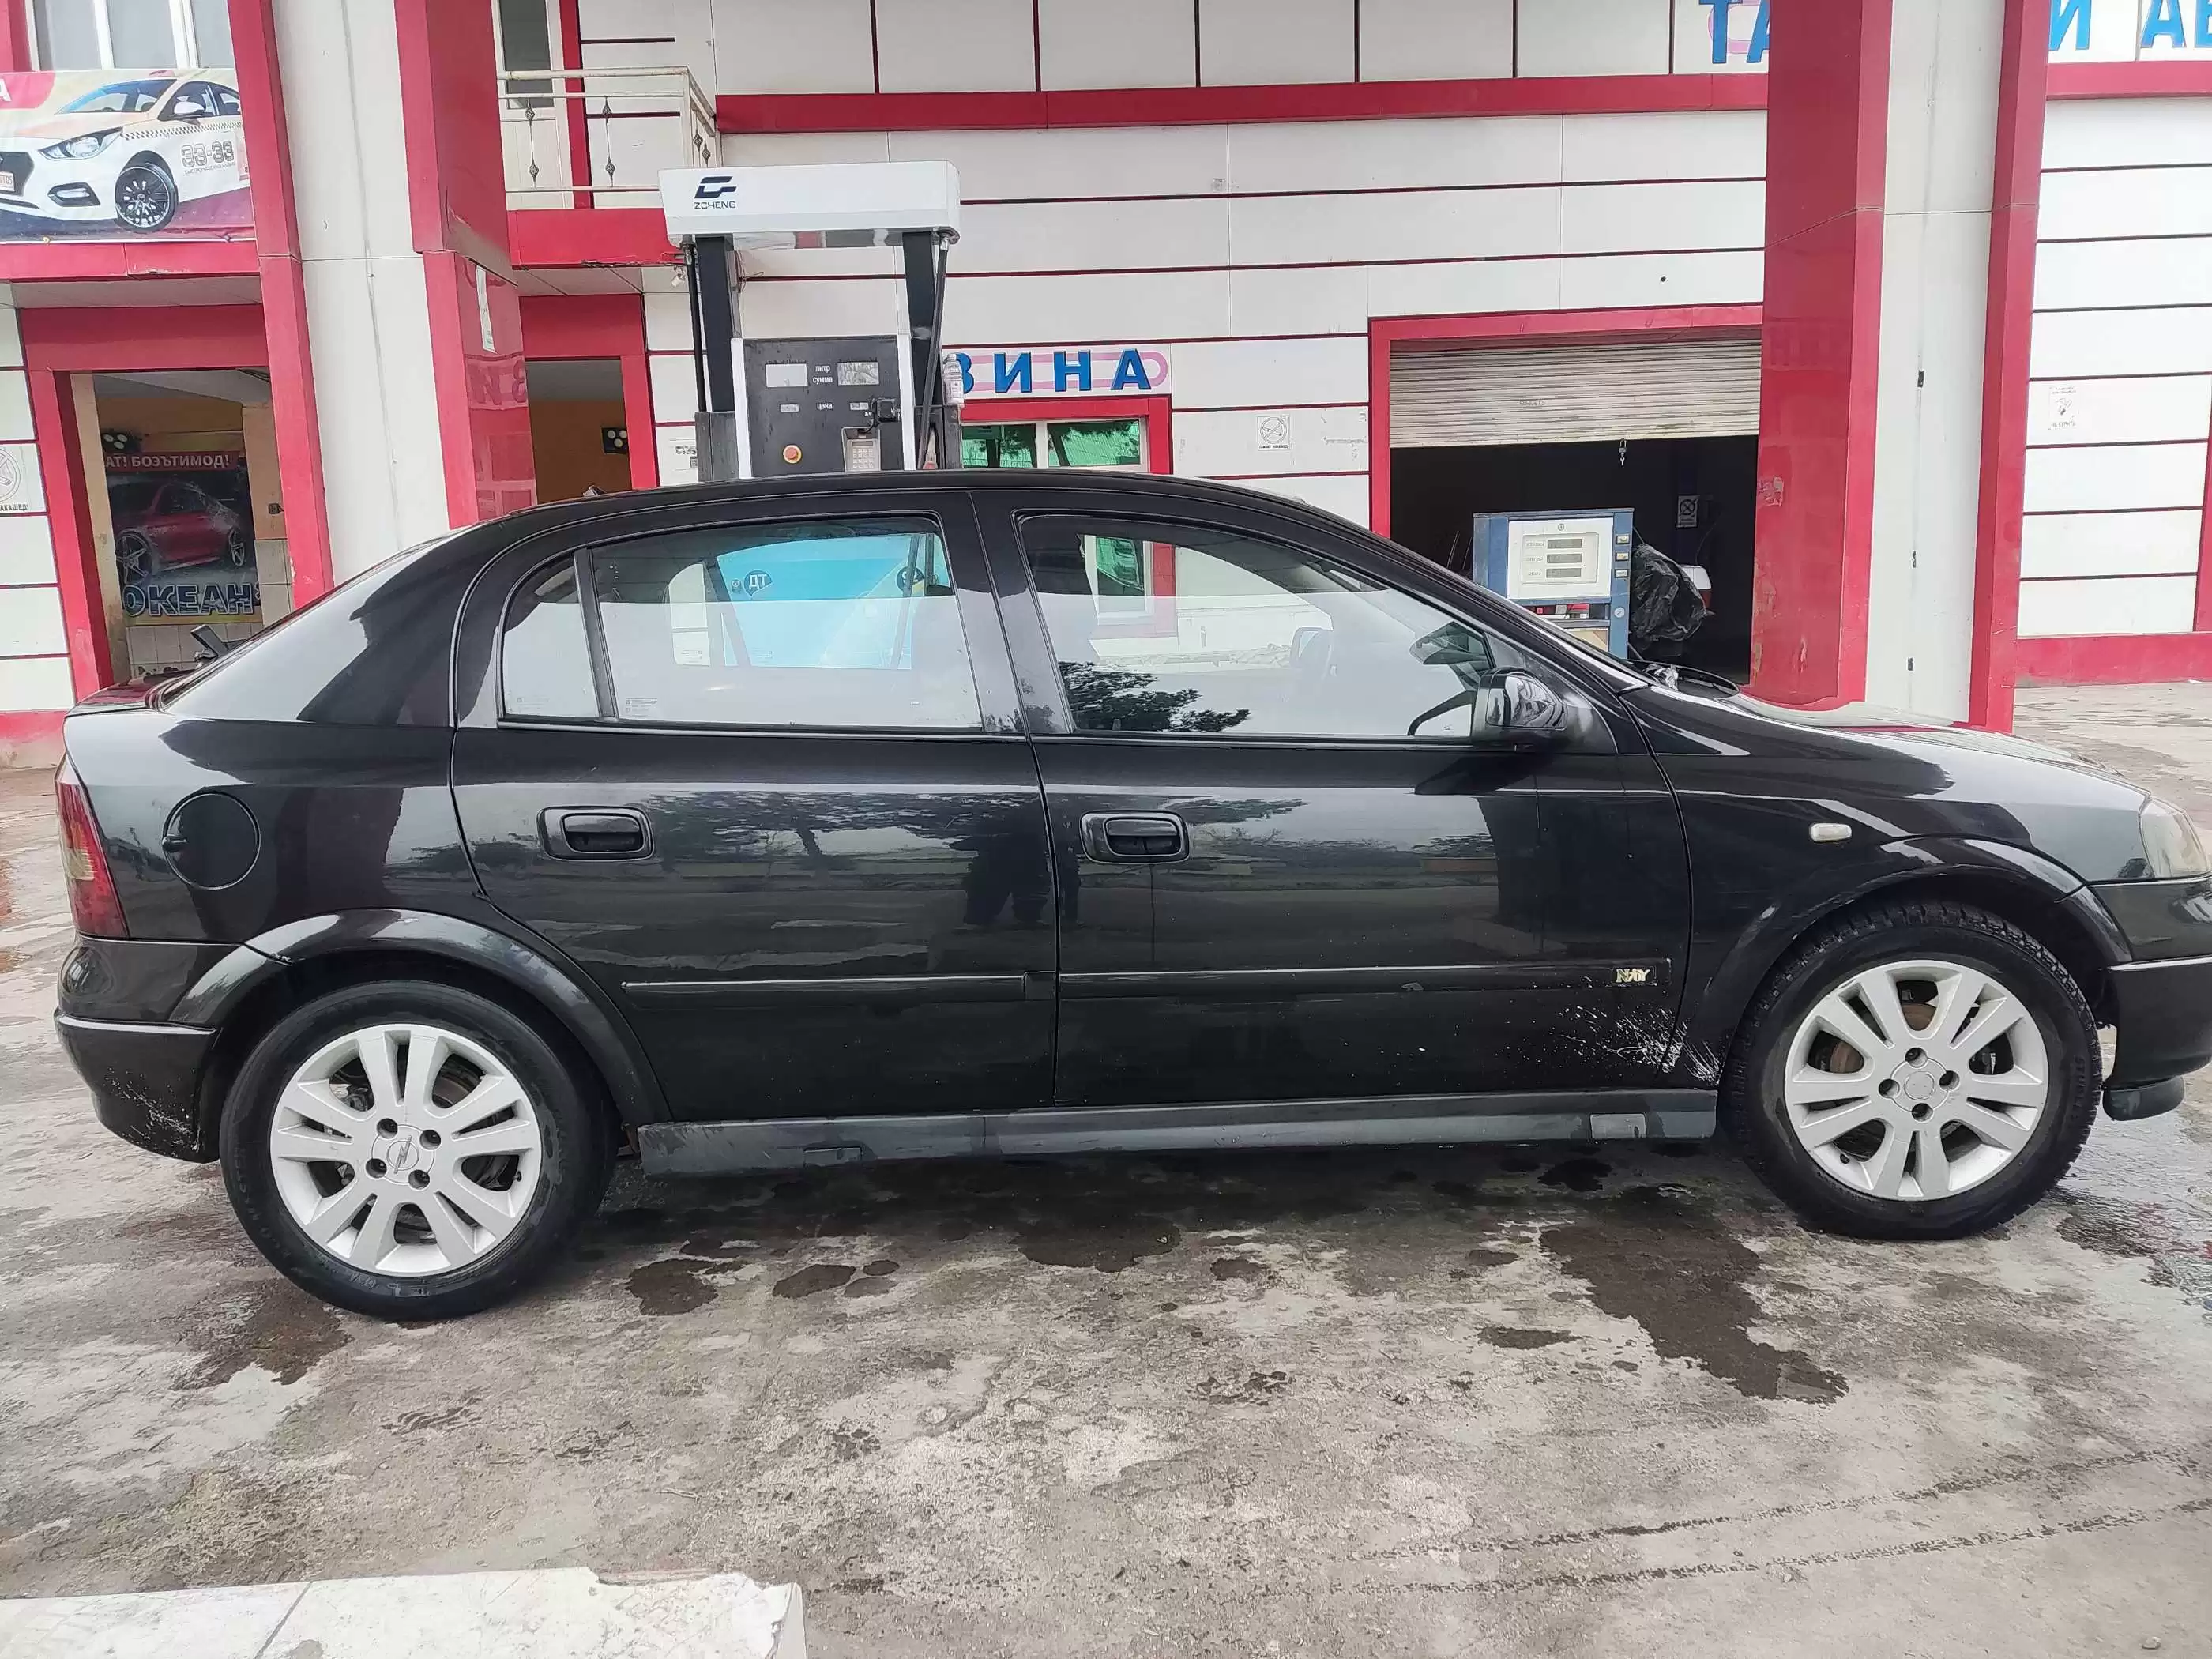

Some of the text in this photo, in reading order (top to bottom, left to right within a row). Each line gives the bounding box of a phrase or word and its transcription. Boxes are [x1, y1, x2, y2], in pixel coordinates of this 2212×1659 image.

[694, 201, 736, 209] ZCHENG
[812, 375, 833, 385] сумма
[749, 574, 768, 589] ДТ
[123, 583, 254, 617] ОКЕАН
